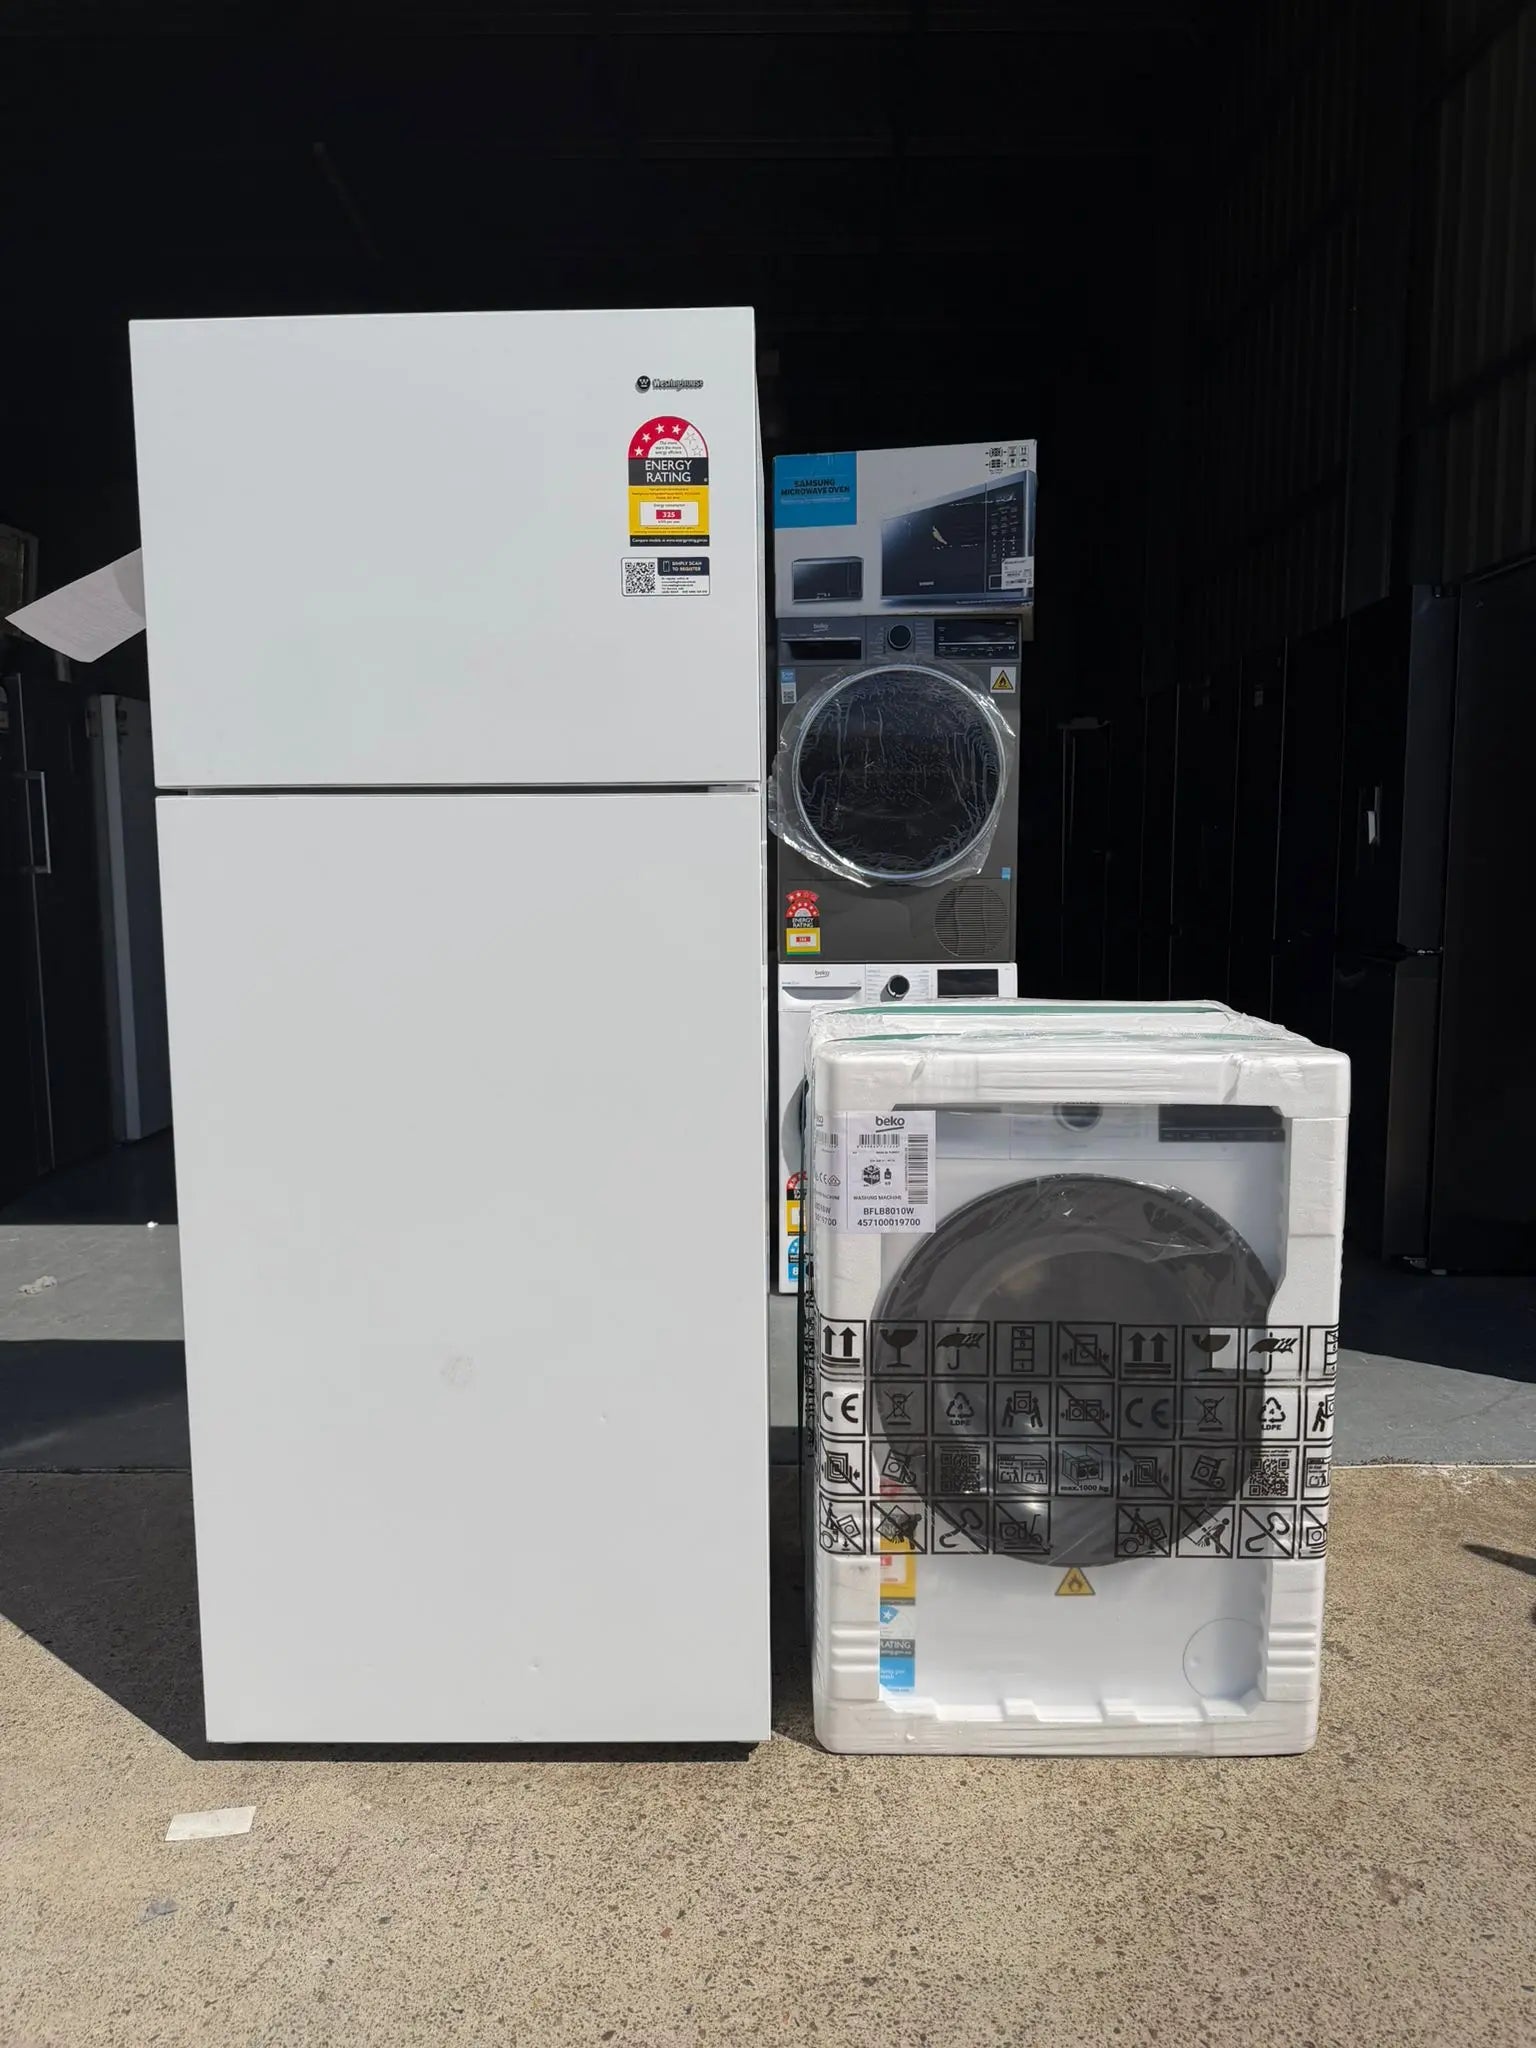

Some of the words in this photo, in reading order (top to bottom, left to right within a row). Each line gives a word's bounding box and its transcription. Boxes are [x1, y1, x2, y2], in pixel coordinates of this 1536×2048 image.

[653, 379, 703, 391] Westinghouse
[645, 460, 692, 471] ENERGY
[646, 472, 691, 482] RATING
[793, 479, 836, 488] SAMSUNG
[780, 486, 828, 496] MICROWAVE
[828, 485, 850, 494] OVEN
[875, 1116, 905, 1126] beko
[864, 1207, 915, 1215] BFLB8010W
[857, 1218, 921, 1226] 457100019700
